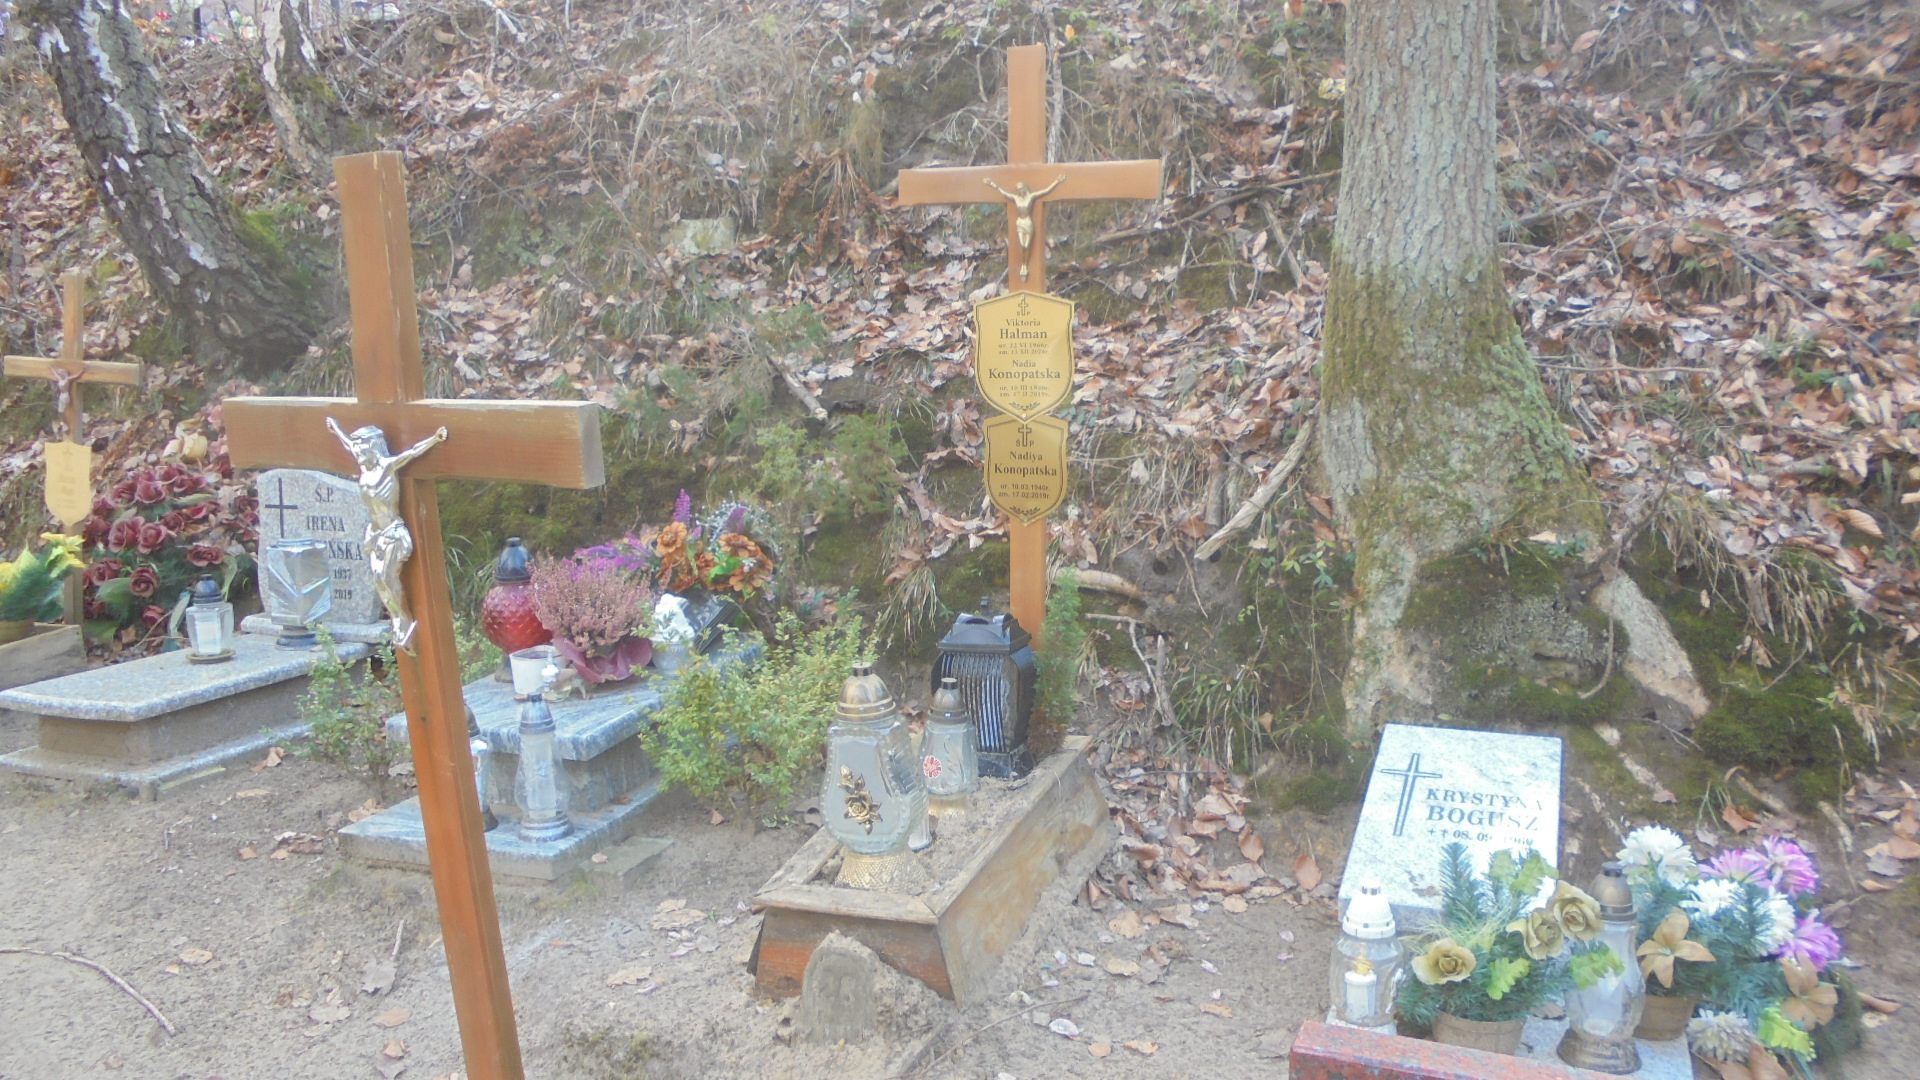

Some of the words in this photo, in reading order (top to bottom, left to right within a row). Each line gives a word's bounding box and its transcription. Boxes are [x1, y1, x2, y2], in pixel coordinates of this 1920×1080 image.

[1006, 318, 1041, 327] Viktoria
[999, 328, 1048, 339] Halman
[1012, 359, 1037, 368] Nadia
[988, 368, 1061, 381] Konopatska
[1009, 451, 1043, 463] Nadiya
[994, 463, 1057, 478] Konopatska
[306, 515, 346, 532] IRENA
[326, 538, 364, 561] ŃSKA
[333, 588, 353, 600] 2019
[1426, 805, 1539, 831] BOGUSZ
